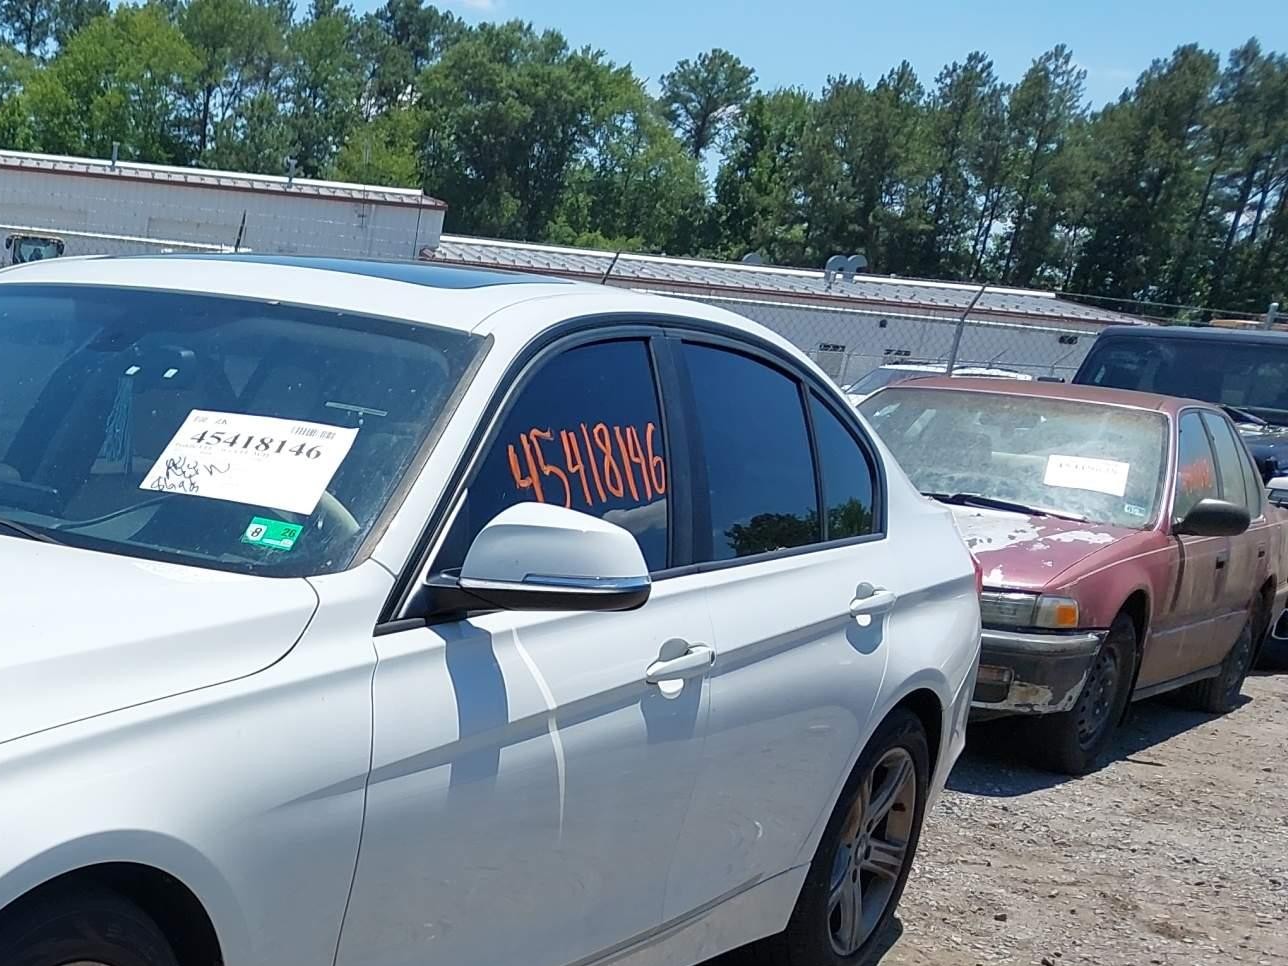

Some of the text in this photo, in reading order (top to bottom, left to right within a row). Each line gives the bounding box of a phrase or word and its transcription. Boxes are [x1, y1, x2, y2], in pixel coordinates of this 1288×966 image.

[190, 429, 323, 460] 45418146
[508, 422, 666, 509] 45418146
[251, 527, 263, 538] 8
